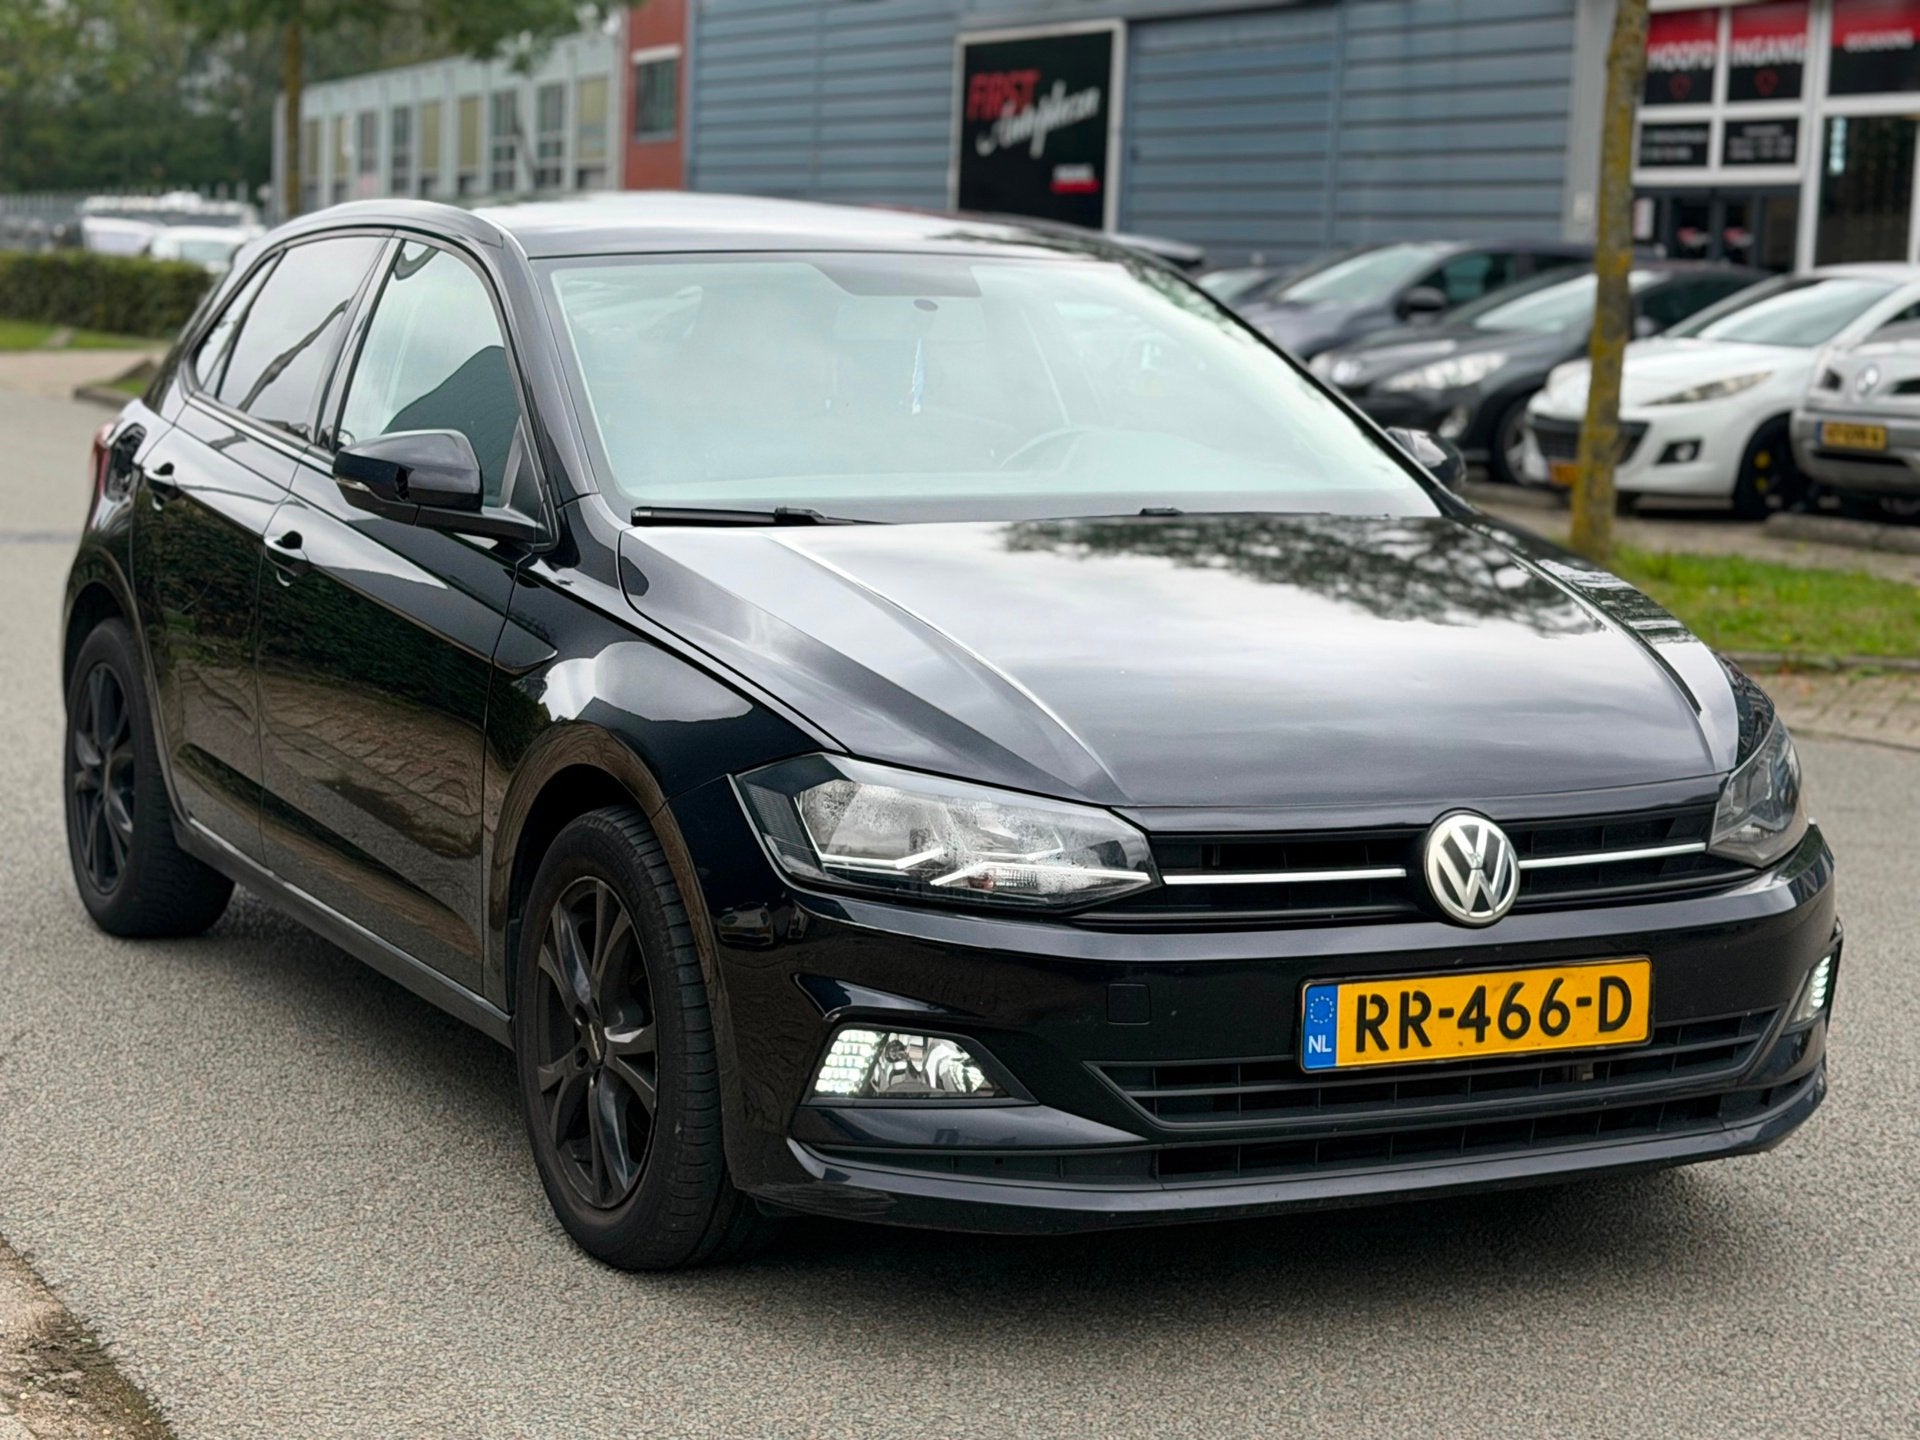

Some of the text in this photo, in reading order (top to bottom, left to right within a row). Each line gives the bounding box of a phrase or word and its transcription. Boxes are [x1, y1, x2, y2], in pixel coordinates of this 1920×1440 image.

[1646, 39, 1717, 72] HOOFD
[967, 69, 1040, 120] FIRST
[1355, 976, 1633, 1053] RR-466-D
[1308, 1034, 1333, 1054] NL
